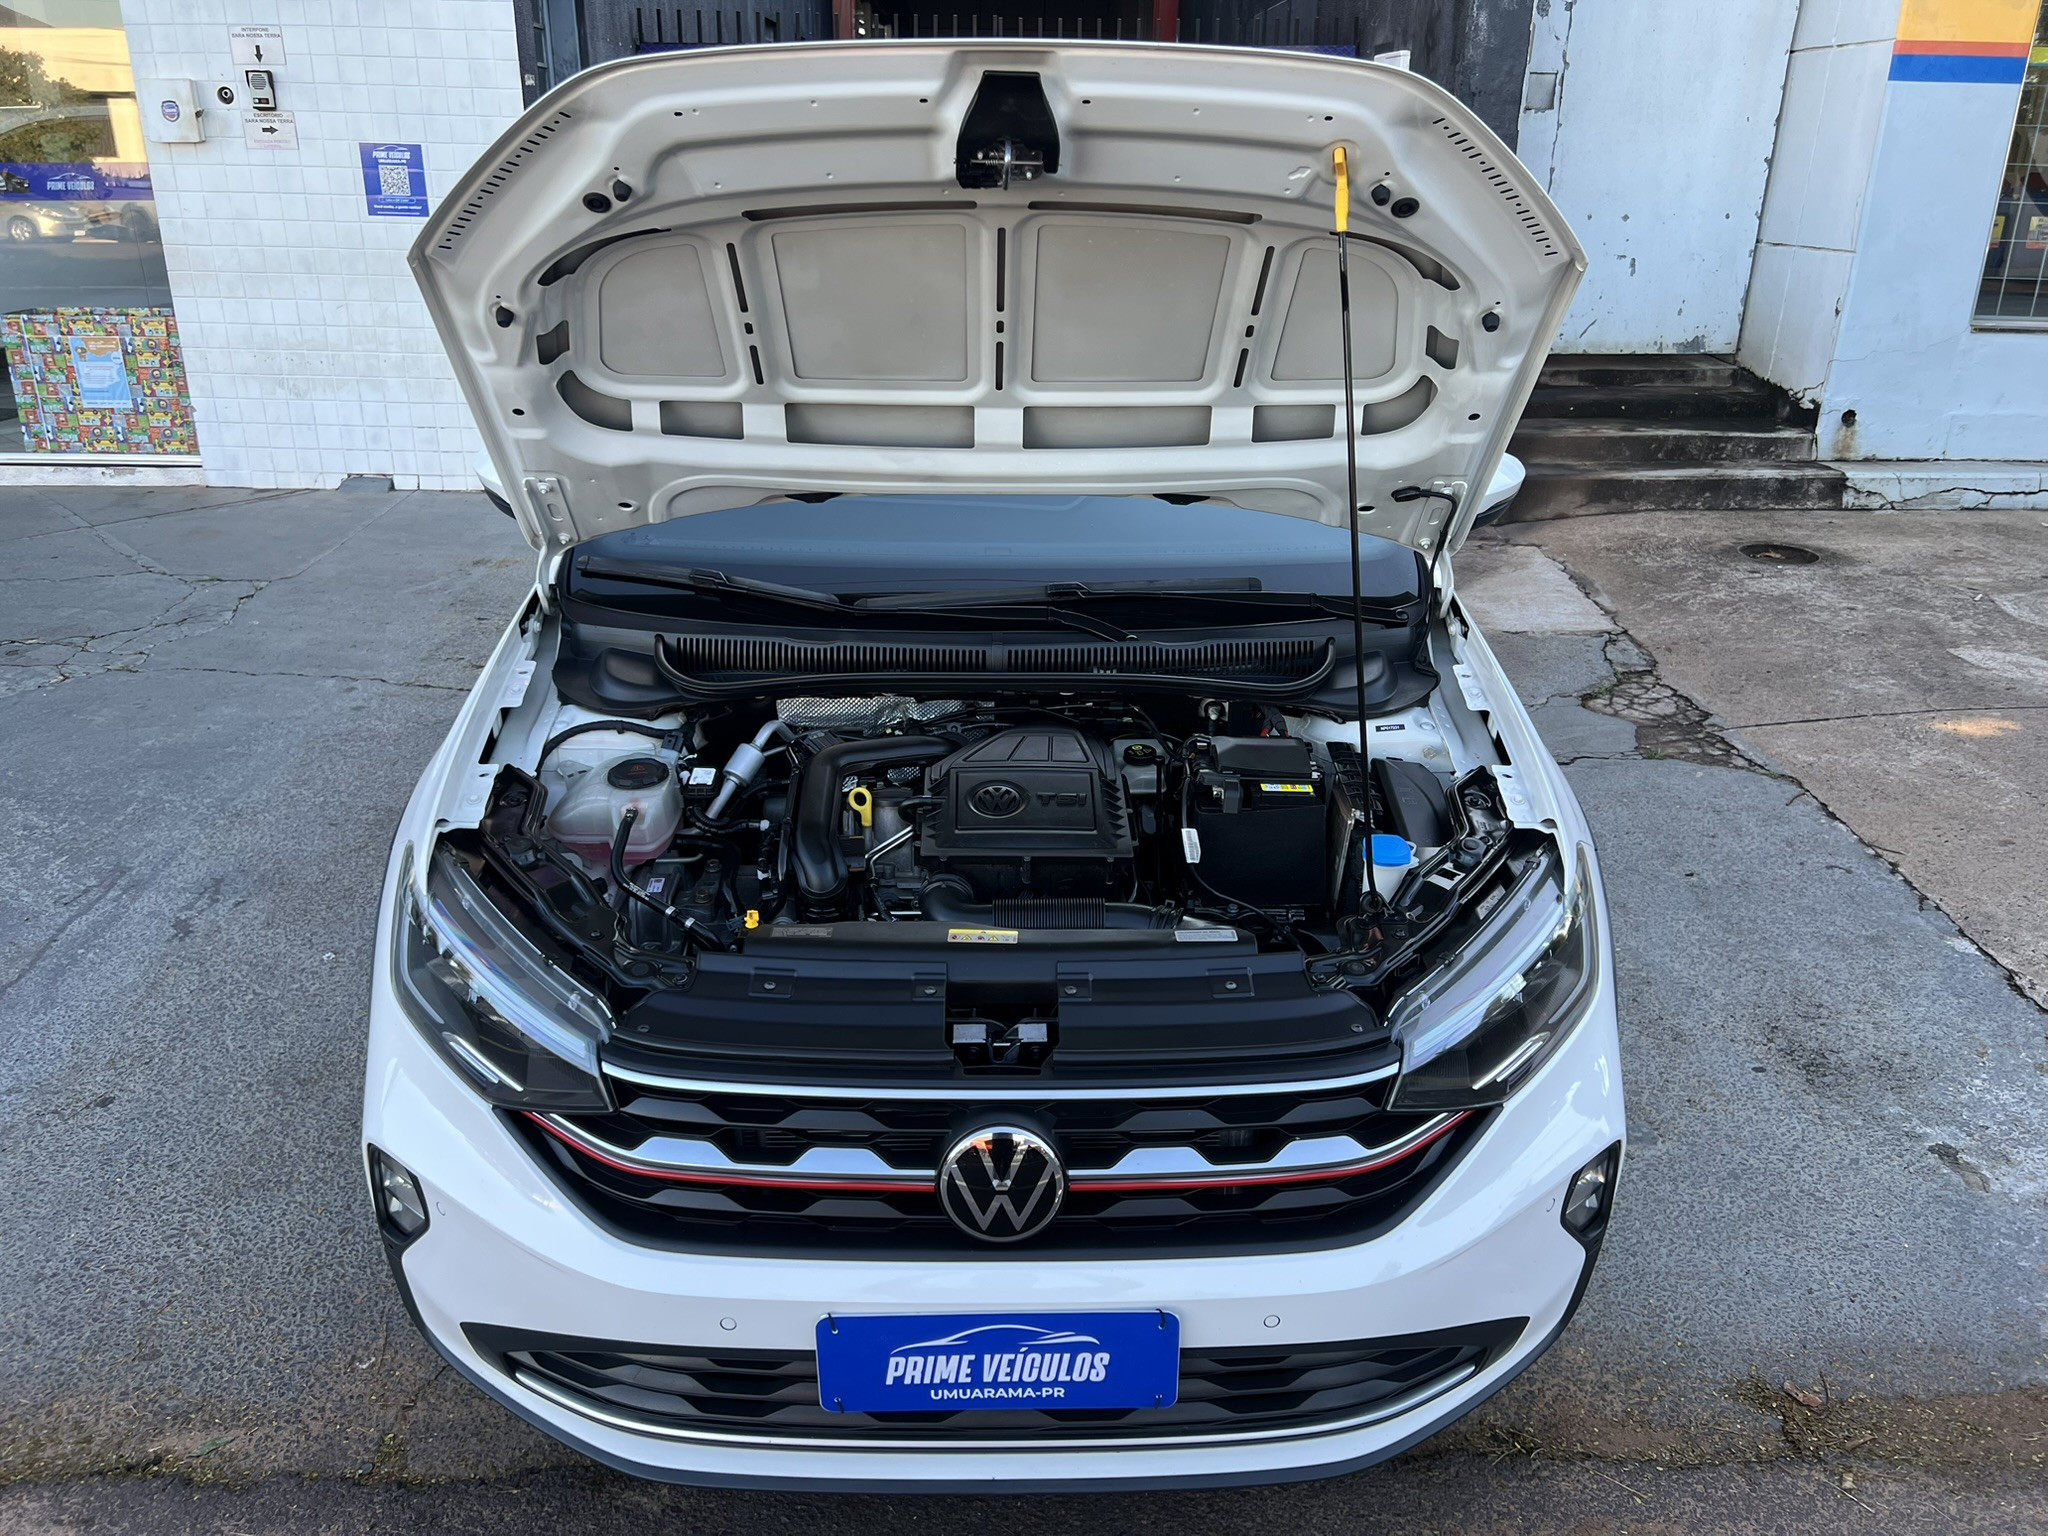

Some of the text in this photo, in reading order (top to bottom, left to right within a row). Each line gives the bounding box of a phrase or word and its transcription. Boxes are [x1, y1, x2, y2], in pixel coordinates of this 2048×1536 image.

[47, 181, 66, 190] PRIME
[1036, 791, 1088, 807] TSI
[885, 1346, 1111, 1385] PRIME VEÍCULOS
[930, 1387, 1066, 1400] UMUARAMA-PR
